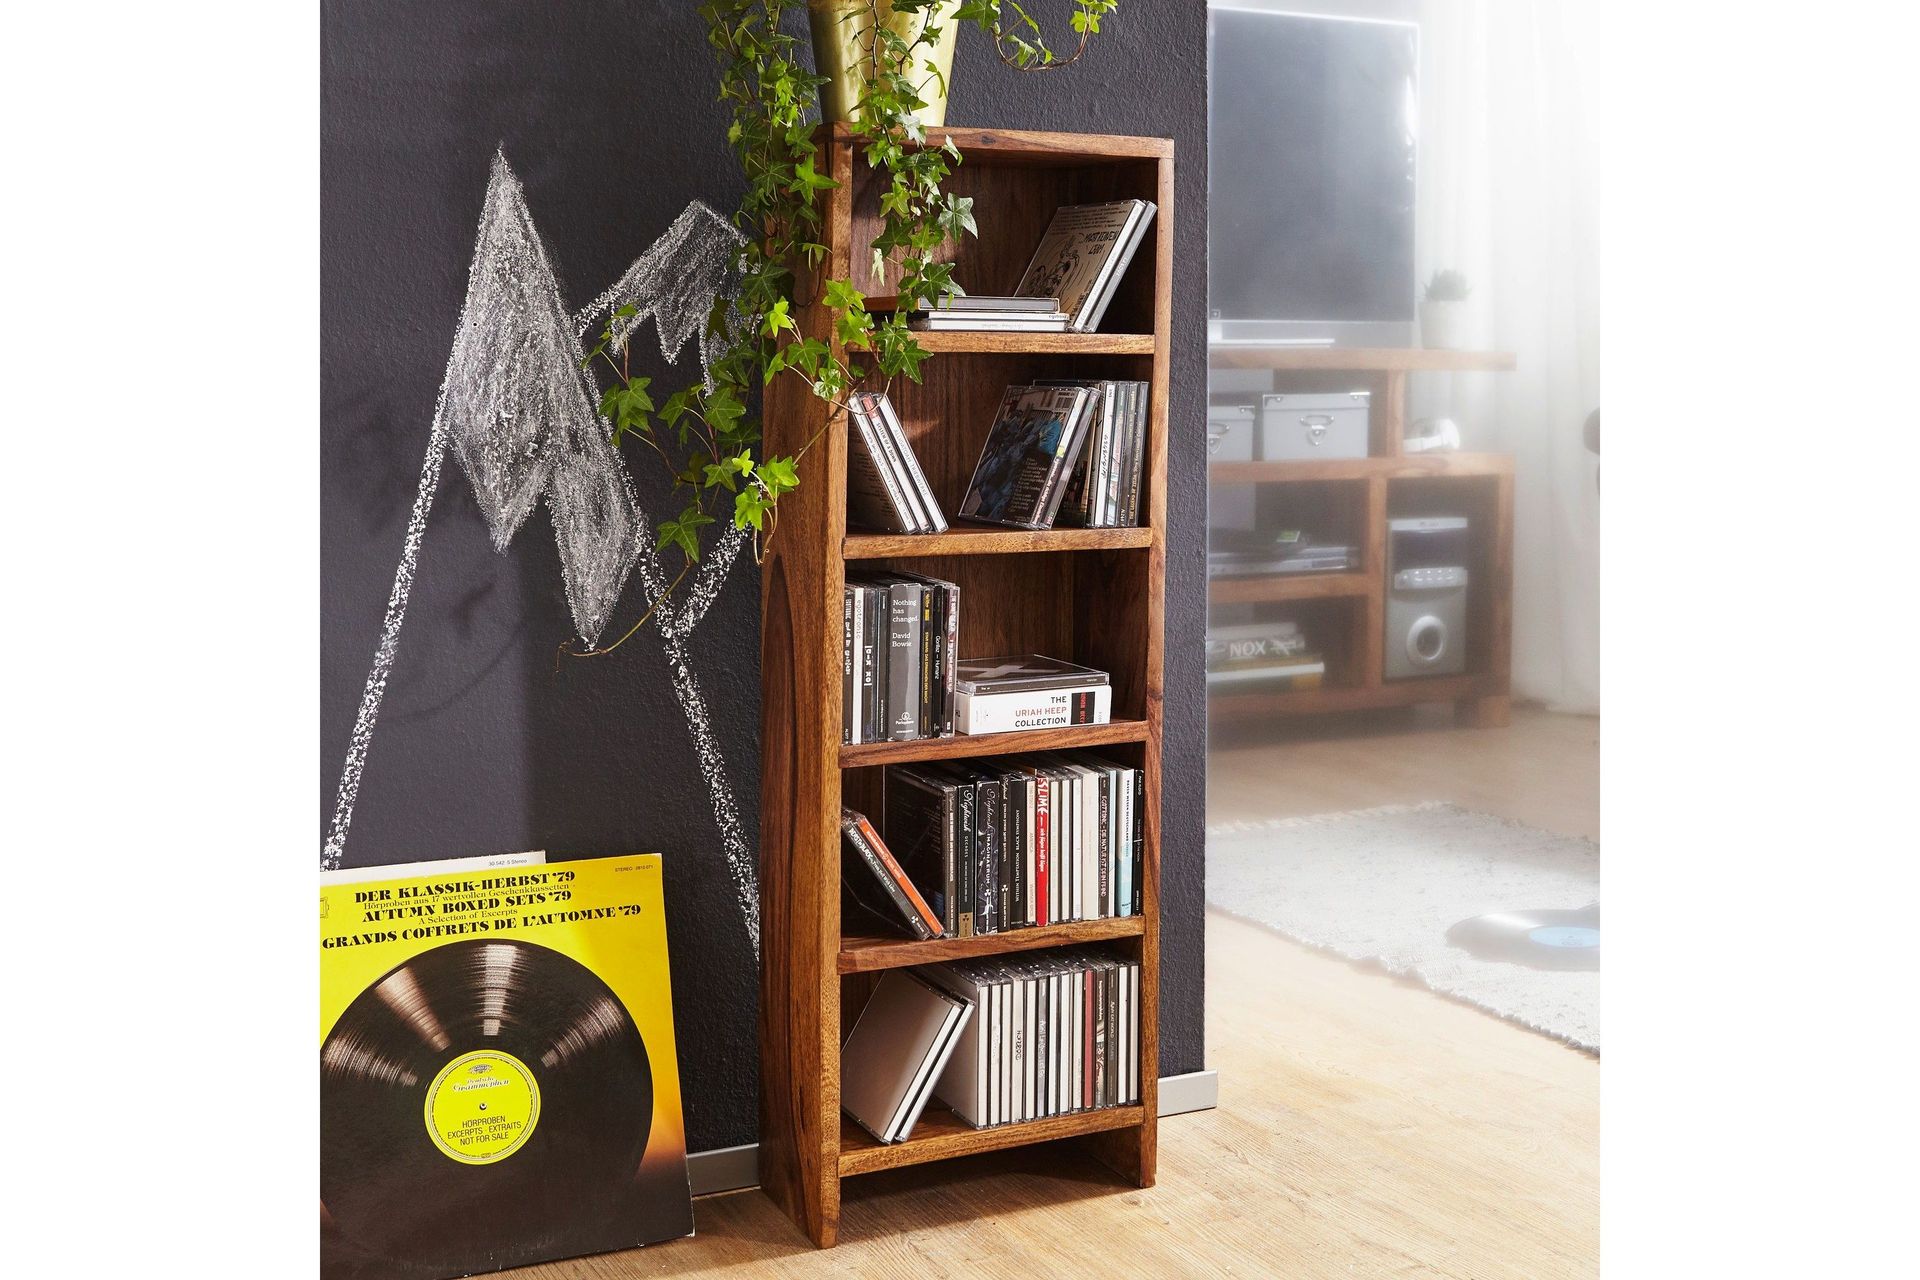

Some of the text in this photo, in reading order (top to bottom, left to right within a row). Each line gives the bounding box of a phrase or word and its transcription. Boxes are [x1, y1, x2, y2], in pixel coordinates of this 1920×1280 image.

[876, 422, 886, 439] SYSTEM
[888, 449, 896, 462] DOWN
[1229, 640, 1266, 657] NOX
[1015, 706, 1067, 717] URIAH HEEP
[1015, 717, 1066, 727] COLLECTION
[984, 788, 995, 829] Nightwish
[1038, 777, 1048, 815] SLIME
[961, 790, 973, 832] Nightwish
[355, 871, 575, 903] DER KLASSIK-HERBST '79
[364, 898, 411, 910] Hörproben
[442, 890, 486, 901] wertvollen
[489, 884, 569, 897] Geschenkkassetten
[363, 890, 572, 922] AUTUMN BOXED SETS '79
[428, 914, 467, 924] Selection
[481, 908, 518, 919] Excerpts
[322, 904, 641, 949] GRANDS COFFRETS DE L'AUTOMNE '79
[448, 1121, 521, 1139] EXCERPTS EXTRAITS
[460, 1132, 508, 1146] NOT FOR SALE
